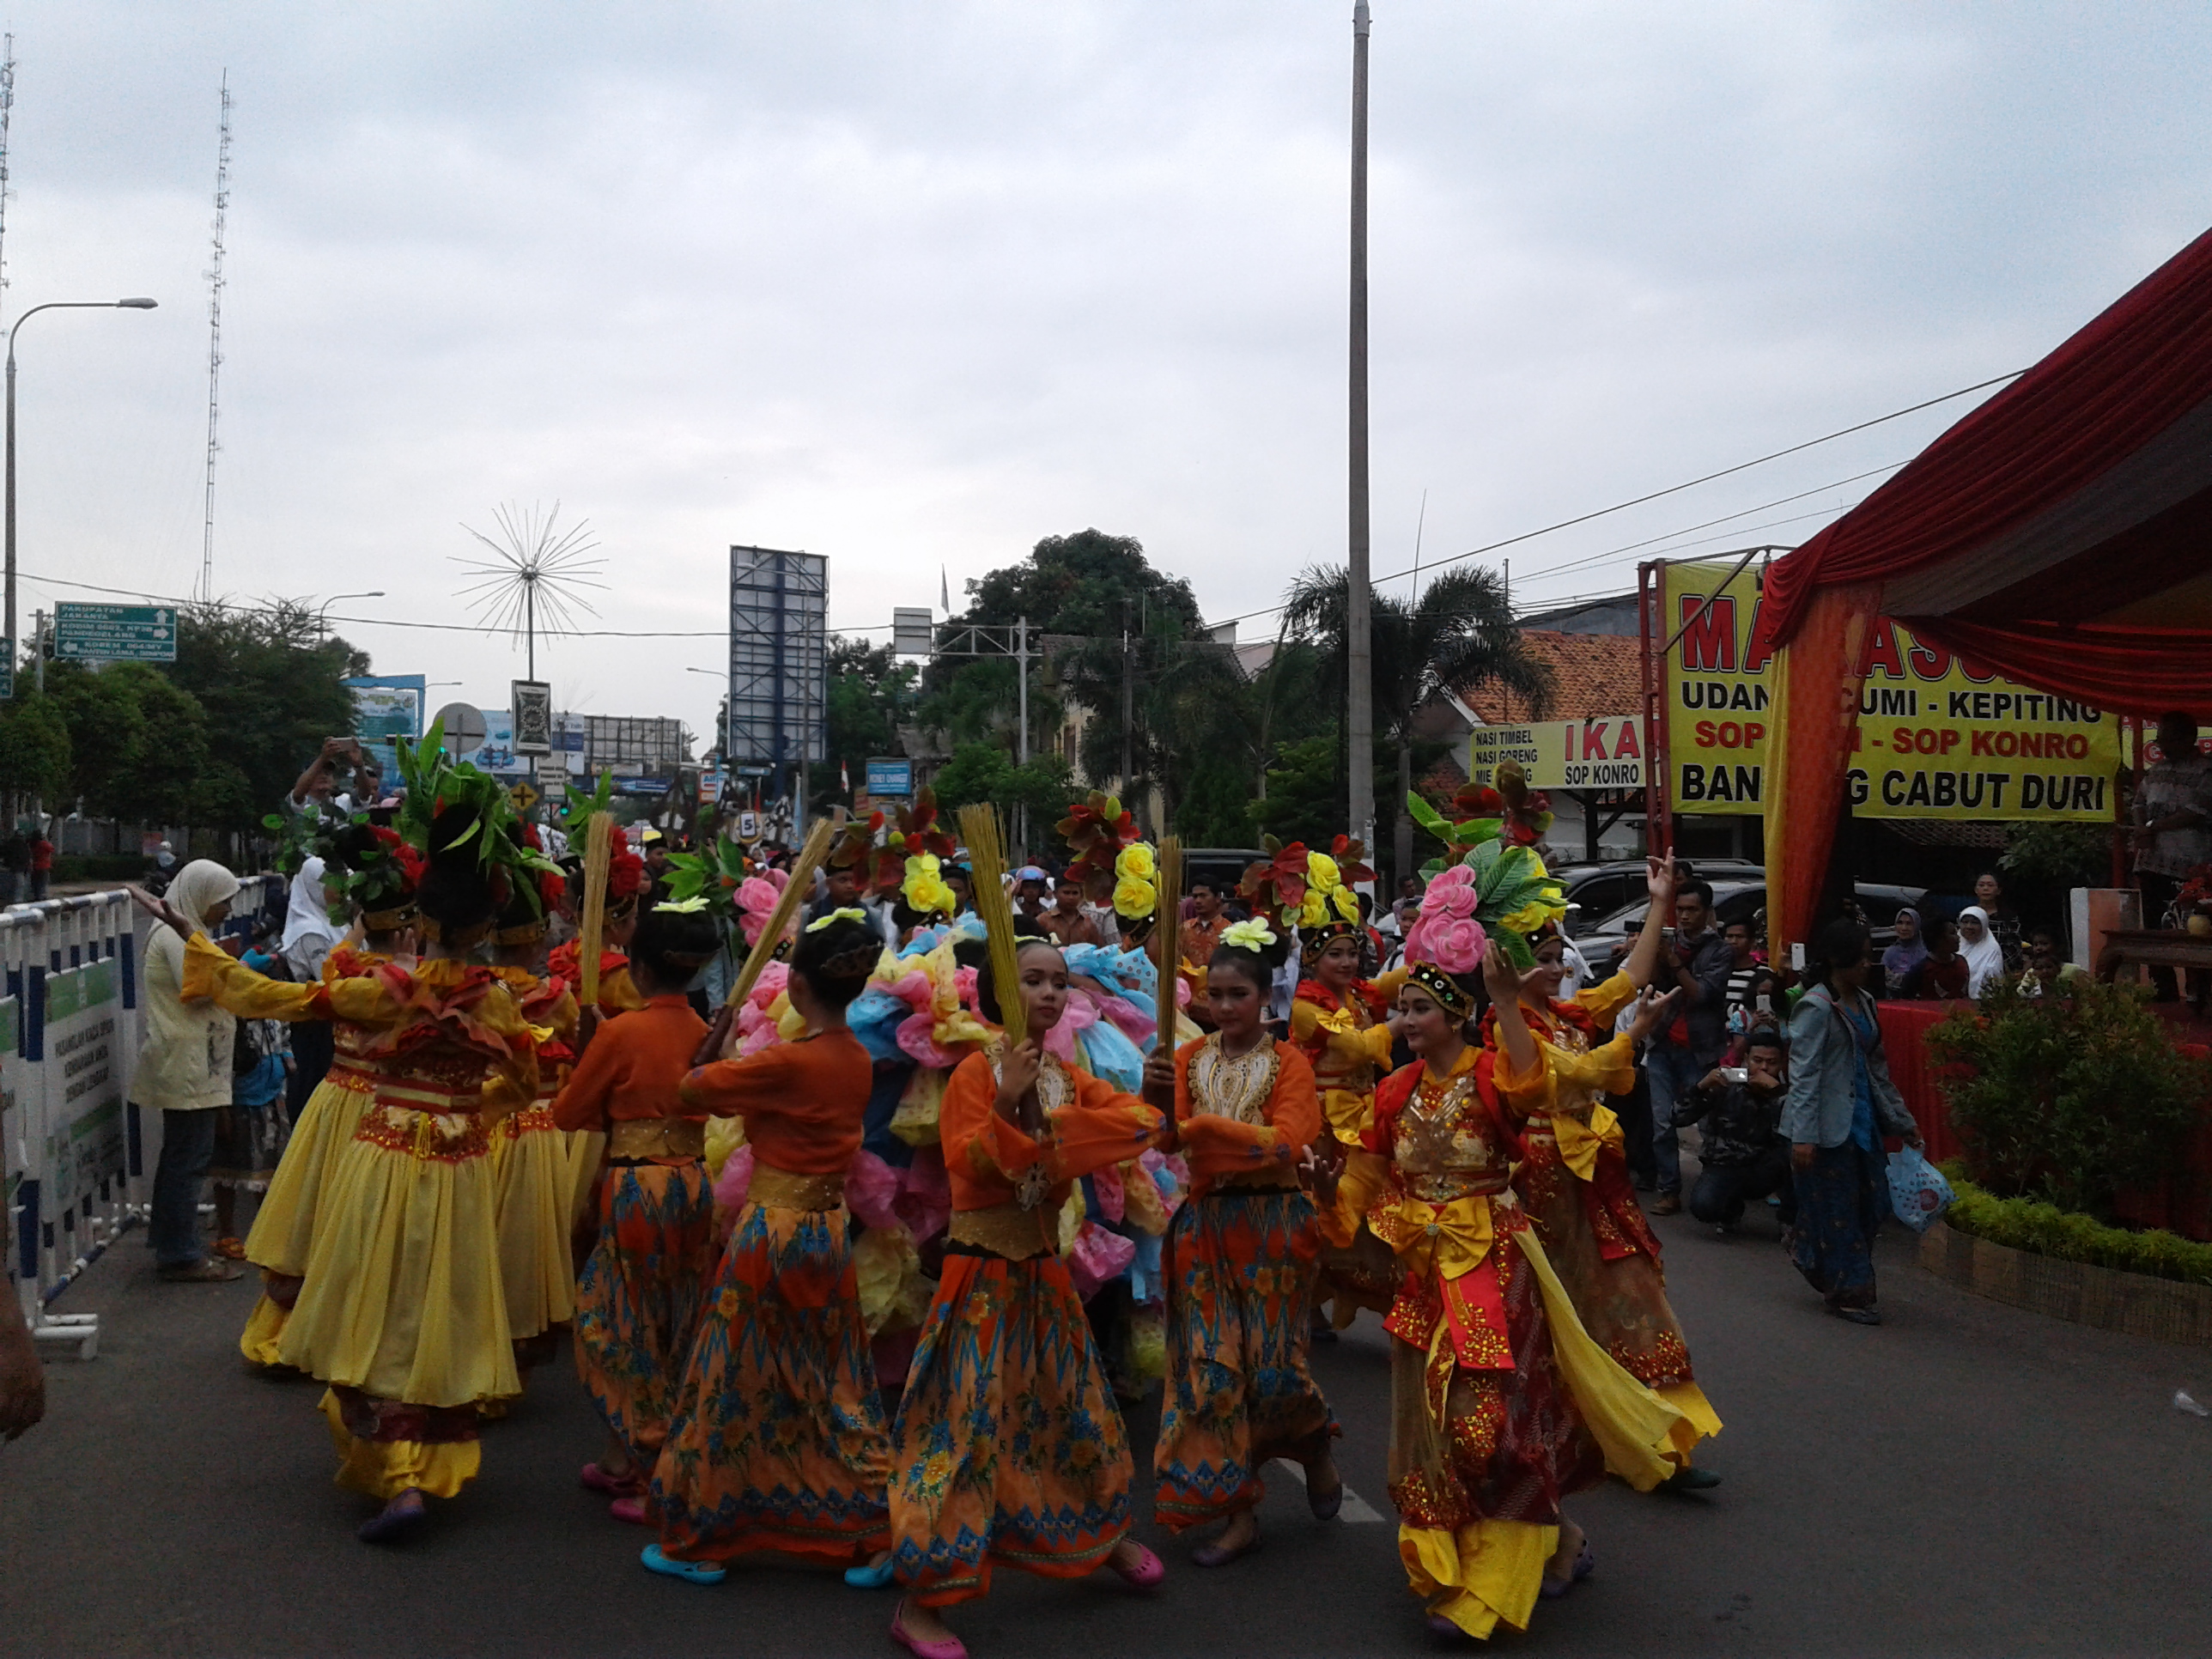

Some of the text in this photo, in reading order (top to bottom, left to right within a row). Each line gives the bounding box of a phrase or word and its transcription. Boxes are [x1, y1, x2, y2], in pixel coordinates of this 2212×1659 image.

[1681, 681, 1769, 711] UDAN
[1948, 691, 2102, 724] KEPITING
[1475, 730, 1534, 746] NASI TIMBEL
[1693, 720, 1766, 749] SOP
[1892, 726, 1960, 756] SOP
[1970, 729, 2090, 760] KONRO
[1475, 750, 1497, 764] NASI
[1475, 769, 1492, 783] MIE
[1565, 763, 1639, 786] SOP KONRO
[1881, 769, 2010, 809] CABUT
[2021, 774, 2104, 811] DURI
[744, 818, 753, 830] 5
